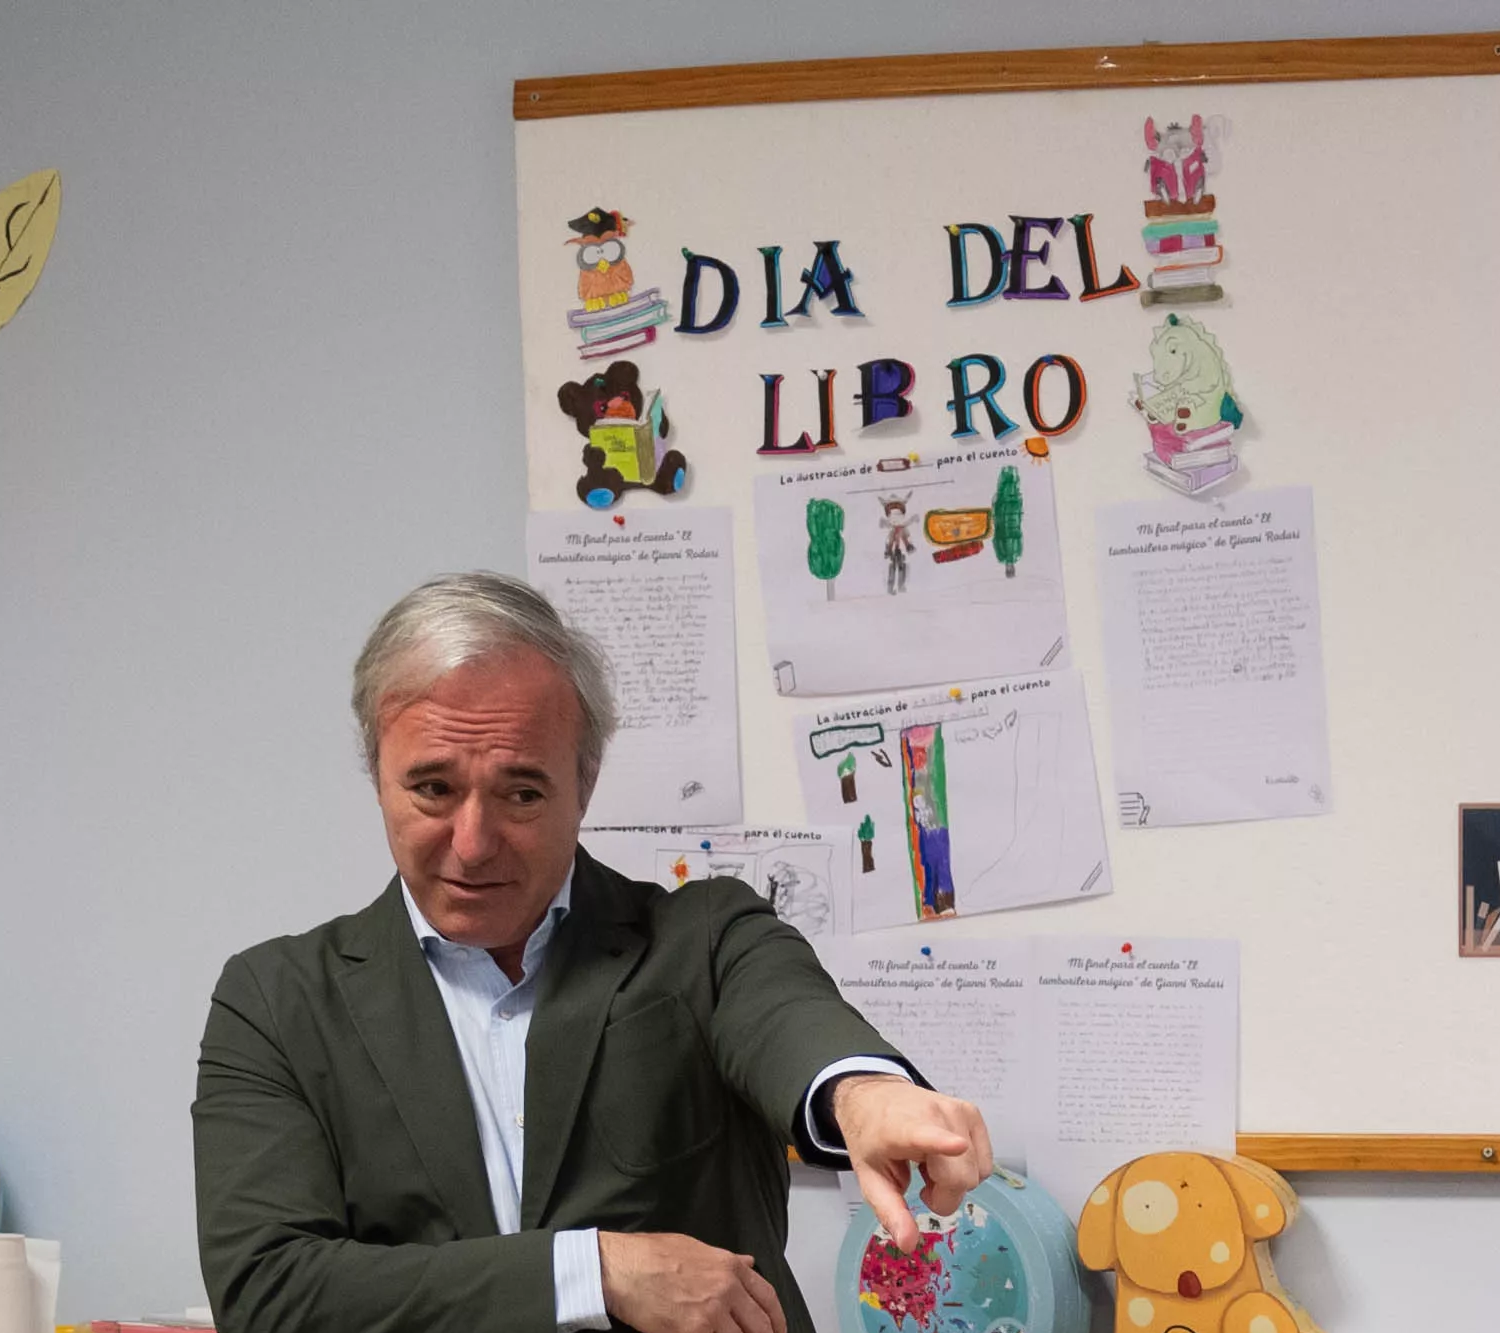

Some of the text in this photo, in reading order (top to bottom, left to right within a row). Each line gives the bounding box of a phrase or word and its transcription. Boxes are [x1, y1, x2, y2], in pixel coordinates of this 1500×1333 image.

[672, 212, 1141, 337] DIA DEL
[757, 352, 1088, 456] LIBRO
[780, 475, 793, 486] La
[860, 464, 872, 474] de
[936, 453, 962, 469] para
[966, 452, 976, 462] el
[979, 448, 1018, 460] cuento
[1137, 520, 1154, 535] Mi
[1154, 520, 1180, 538] final
[1181, 519, 1206, 534] para
[566, 532, 631, 547] Mi final para
[1214, 536, 1227, 548] de
[637, 550, 649, 561] de
[817, 714, 830, 725] La
[896, 701, 908, 712] de
[971, 688, 996, 702] para
[1000, 684, 1009, 694] el
[1013, 679, 1050, 691] cuento
[744, 829, 822, 841] para cuento
[868, 960, 885, 971] Mi
[886, 960, 910, 973] final
[911, 960, 935, 973] para
[1068, 958, 1084, 969] Mi
[1085, 958, 1110, 972] final
[1110, 959, 1134, 972] para
[941, 978, 953, 988] de
[1140, 978, 1152, 988] de
